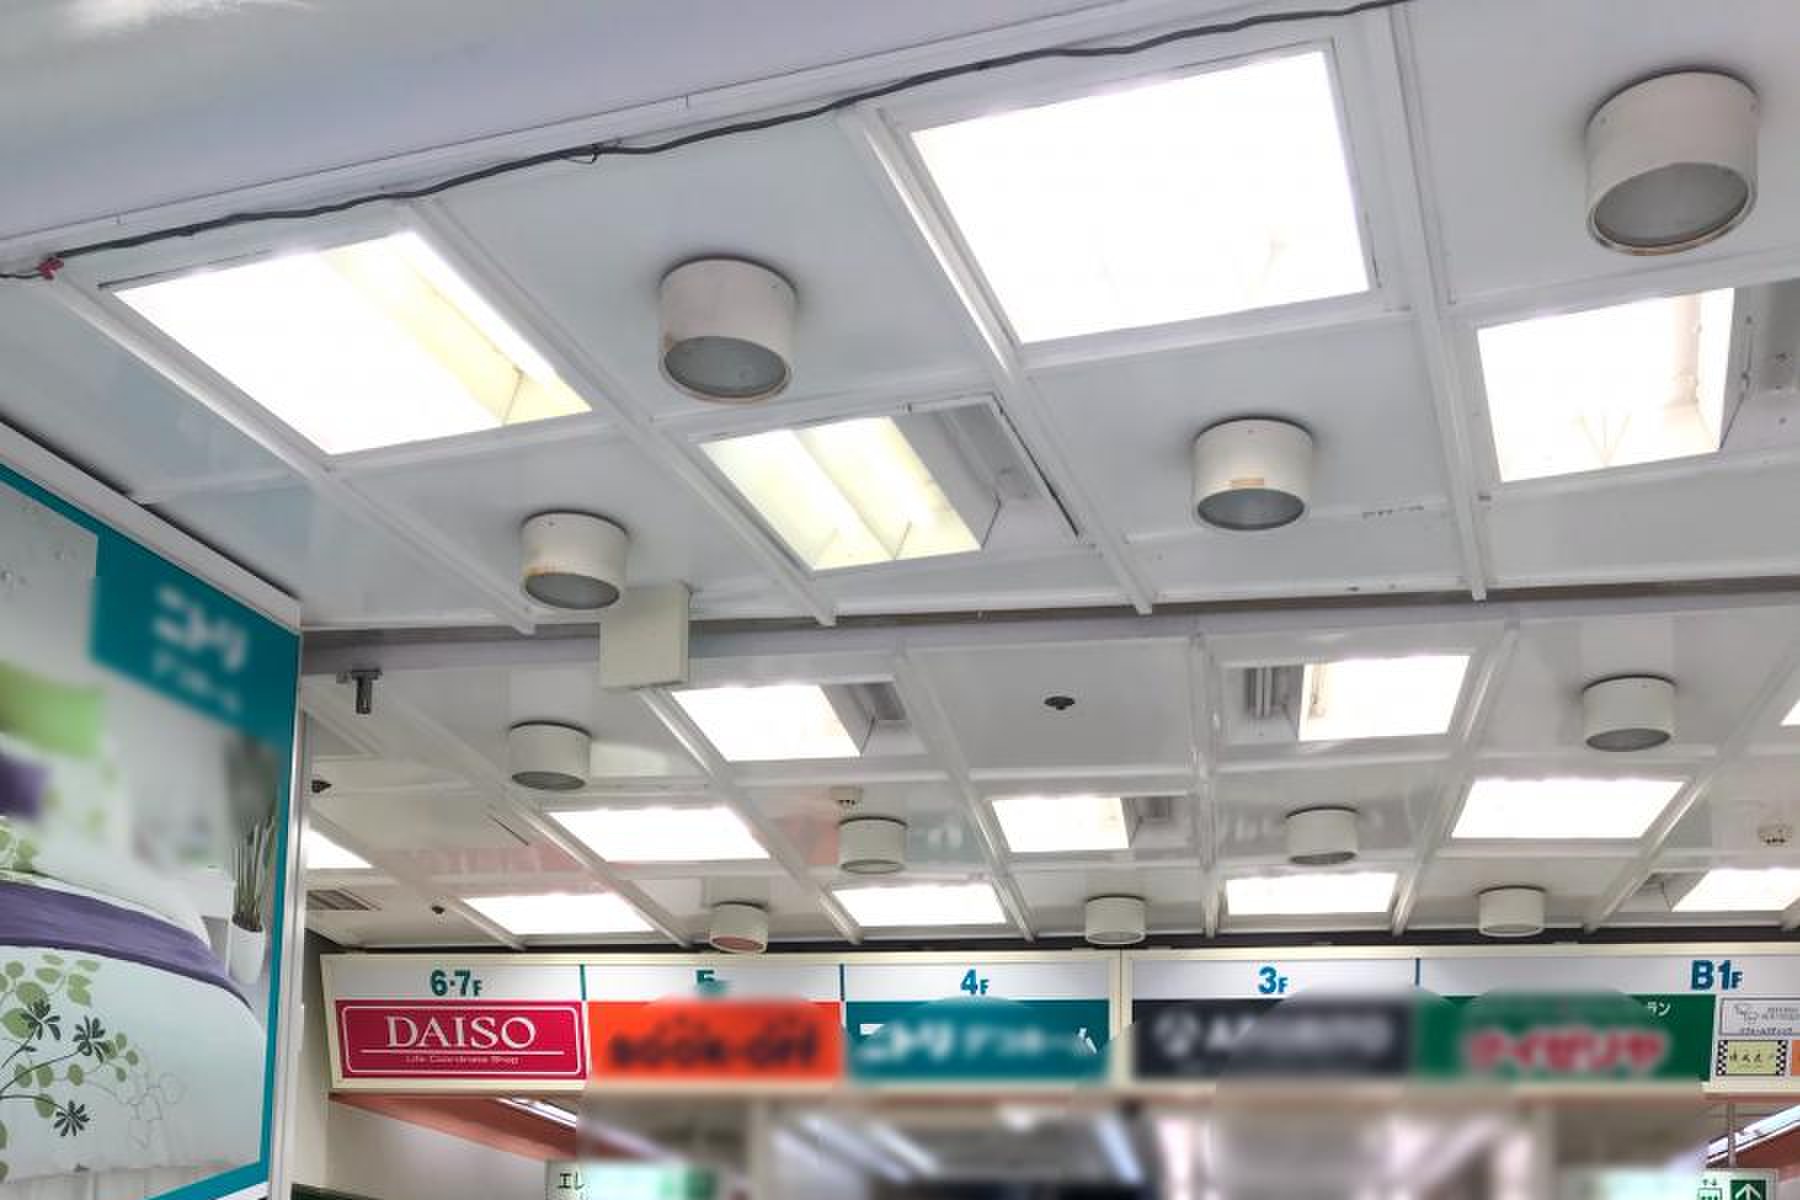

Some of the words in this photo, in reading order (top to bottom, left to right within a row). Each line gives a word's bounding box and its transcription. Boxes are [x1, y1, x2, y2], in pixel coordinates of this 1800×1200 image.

[960, 969, 990, 995] 4F
[1257, 966, 1288, 994] 3F
[1691, 959, 1743, 990] B1F
[384, 1015, 536, 1049] DAISO
